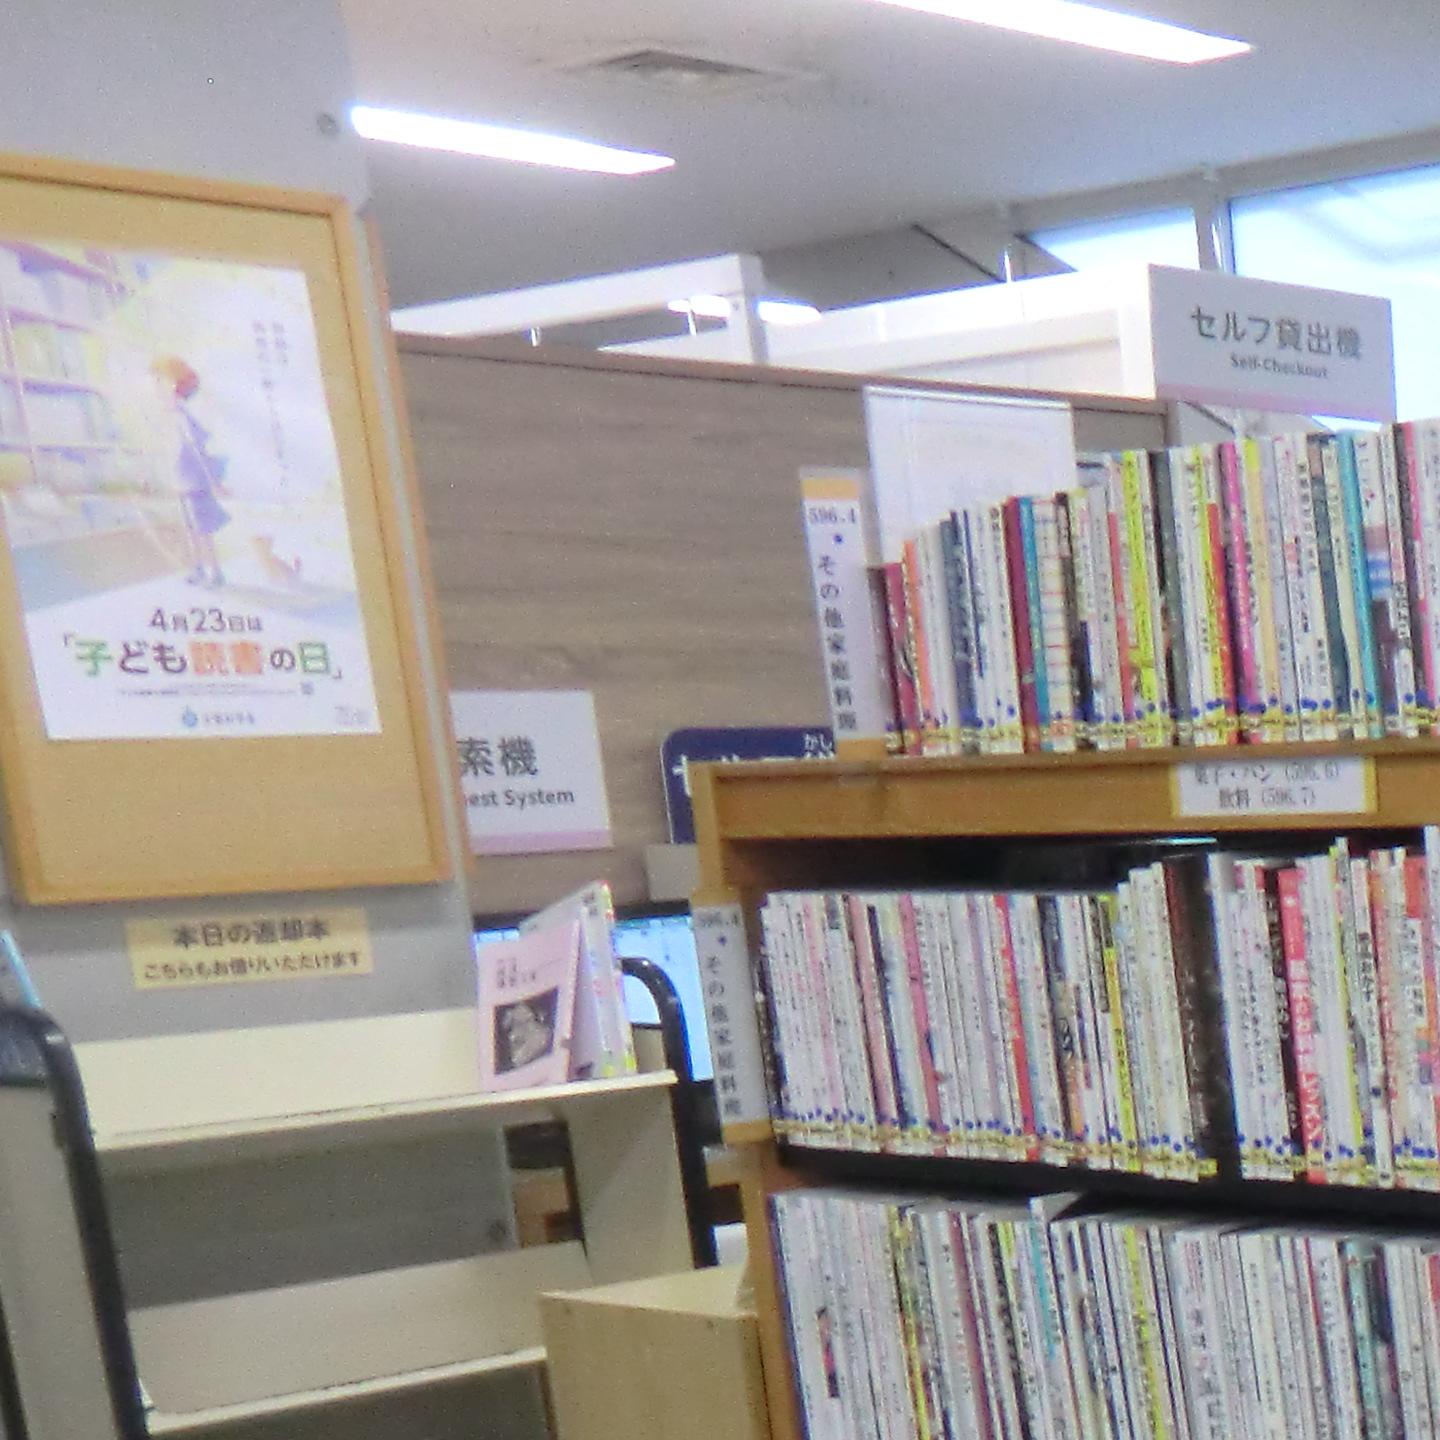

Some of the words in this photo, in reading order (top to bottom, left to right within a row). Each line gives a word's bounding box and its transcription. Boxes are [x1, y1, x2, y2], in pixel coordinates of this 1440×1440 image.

[1190, 305, 1361, 359] セルフ貸出機
[1229, 353, 1328, 379] Self-Checkout
[149, 606, 264, 633] 4月23日は
[62, 631, 344, 680] 「子ども読書の日」
[504, 787, 575, 811] System
[1218, 786, 1250, 809] 飲料
[174, 917, 331, 949] 本日の返却本
